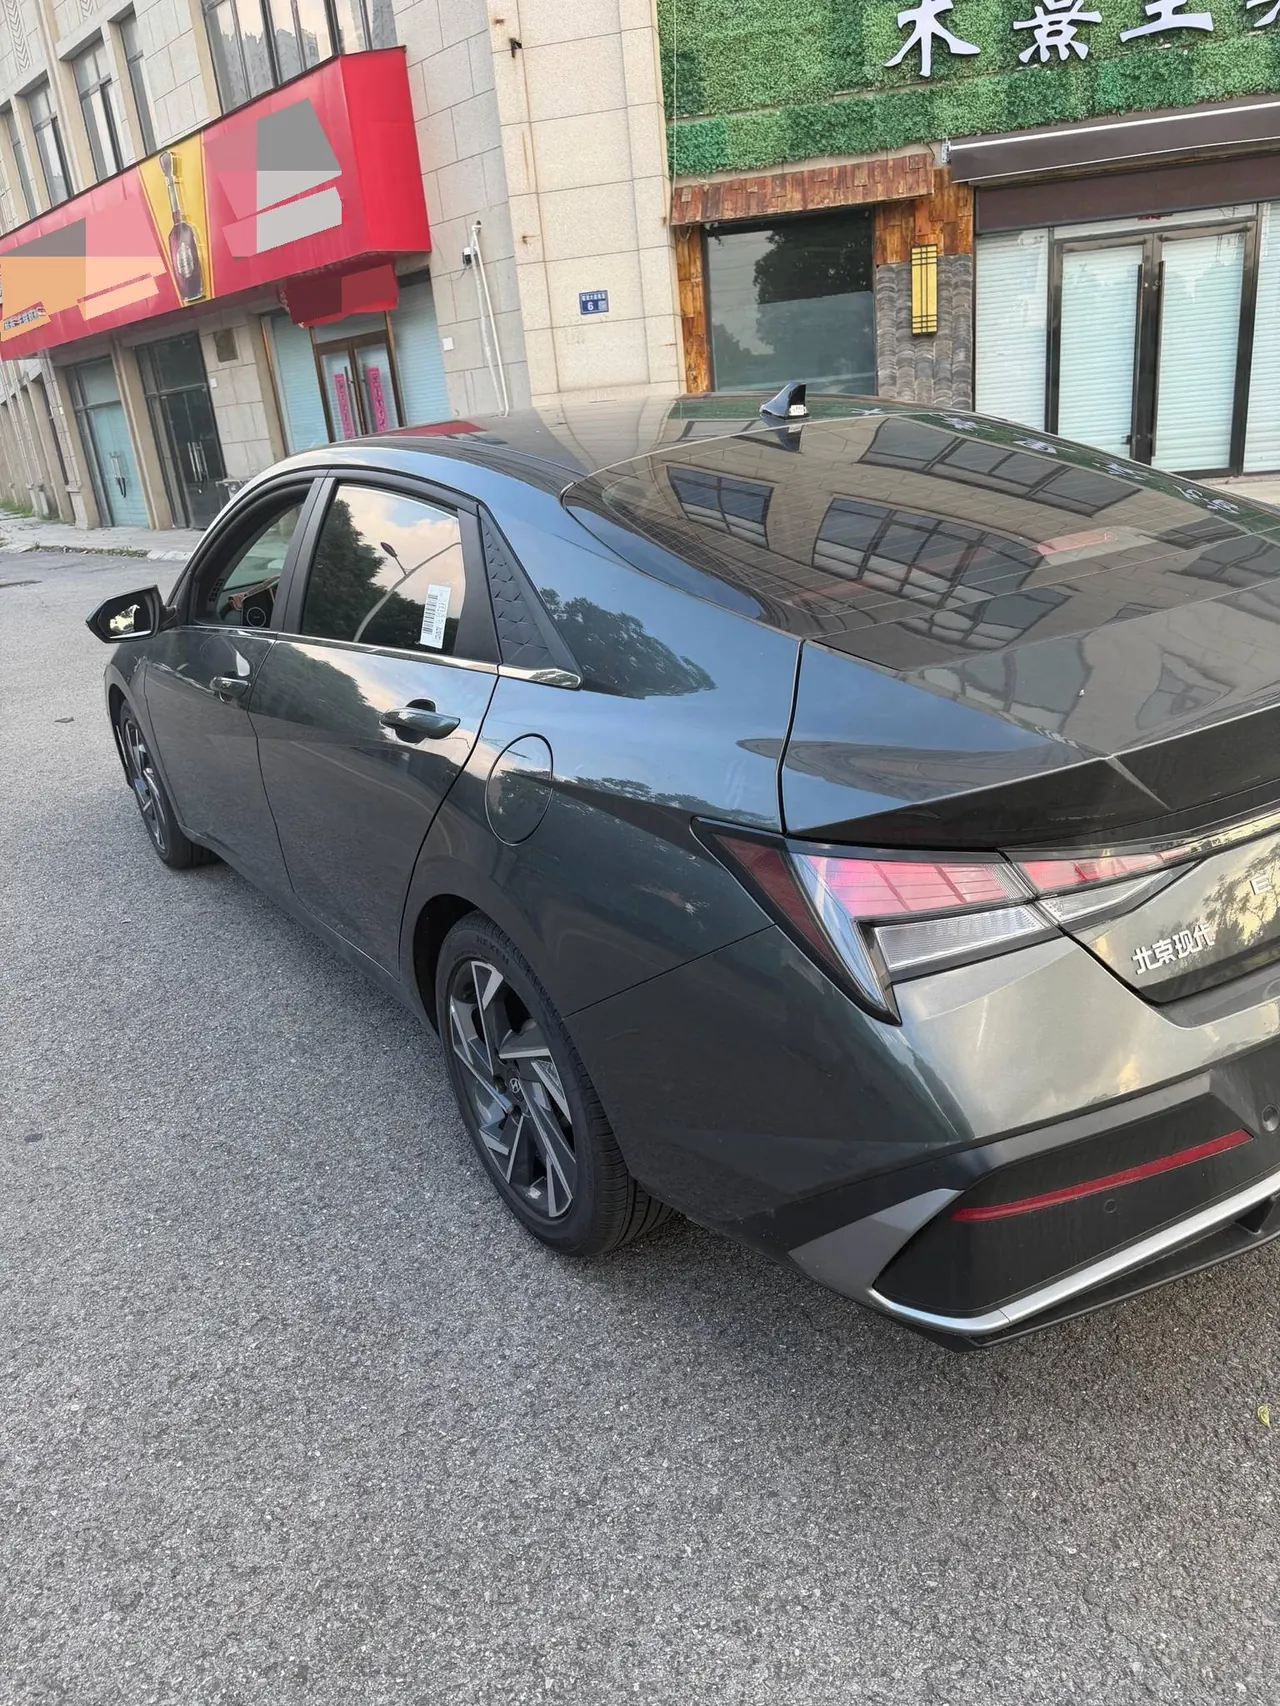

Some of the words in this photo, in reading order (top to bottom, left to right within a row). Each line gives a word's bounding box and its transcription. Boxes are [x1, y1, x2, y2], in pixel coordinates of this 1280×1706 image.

[587, 301, 595, 311] 6
[1131, 923, 1215, 975] 北京现代
